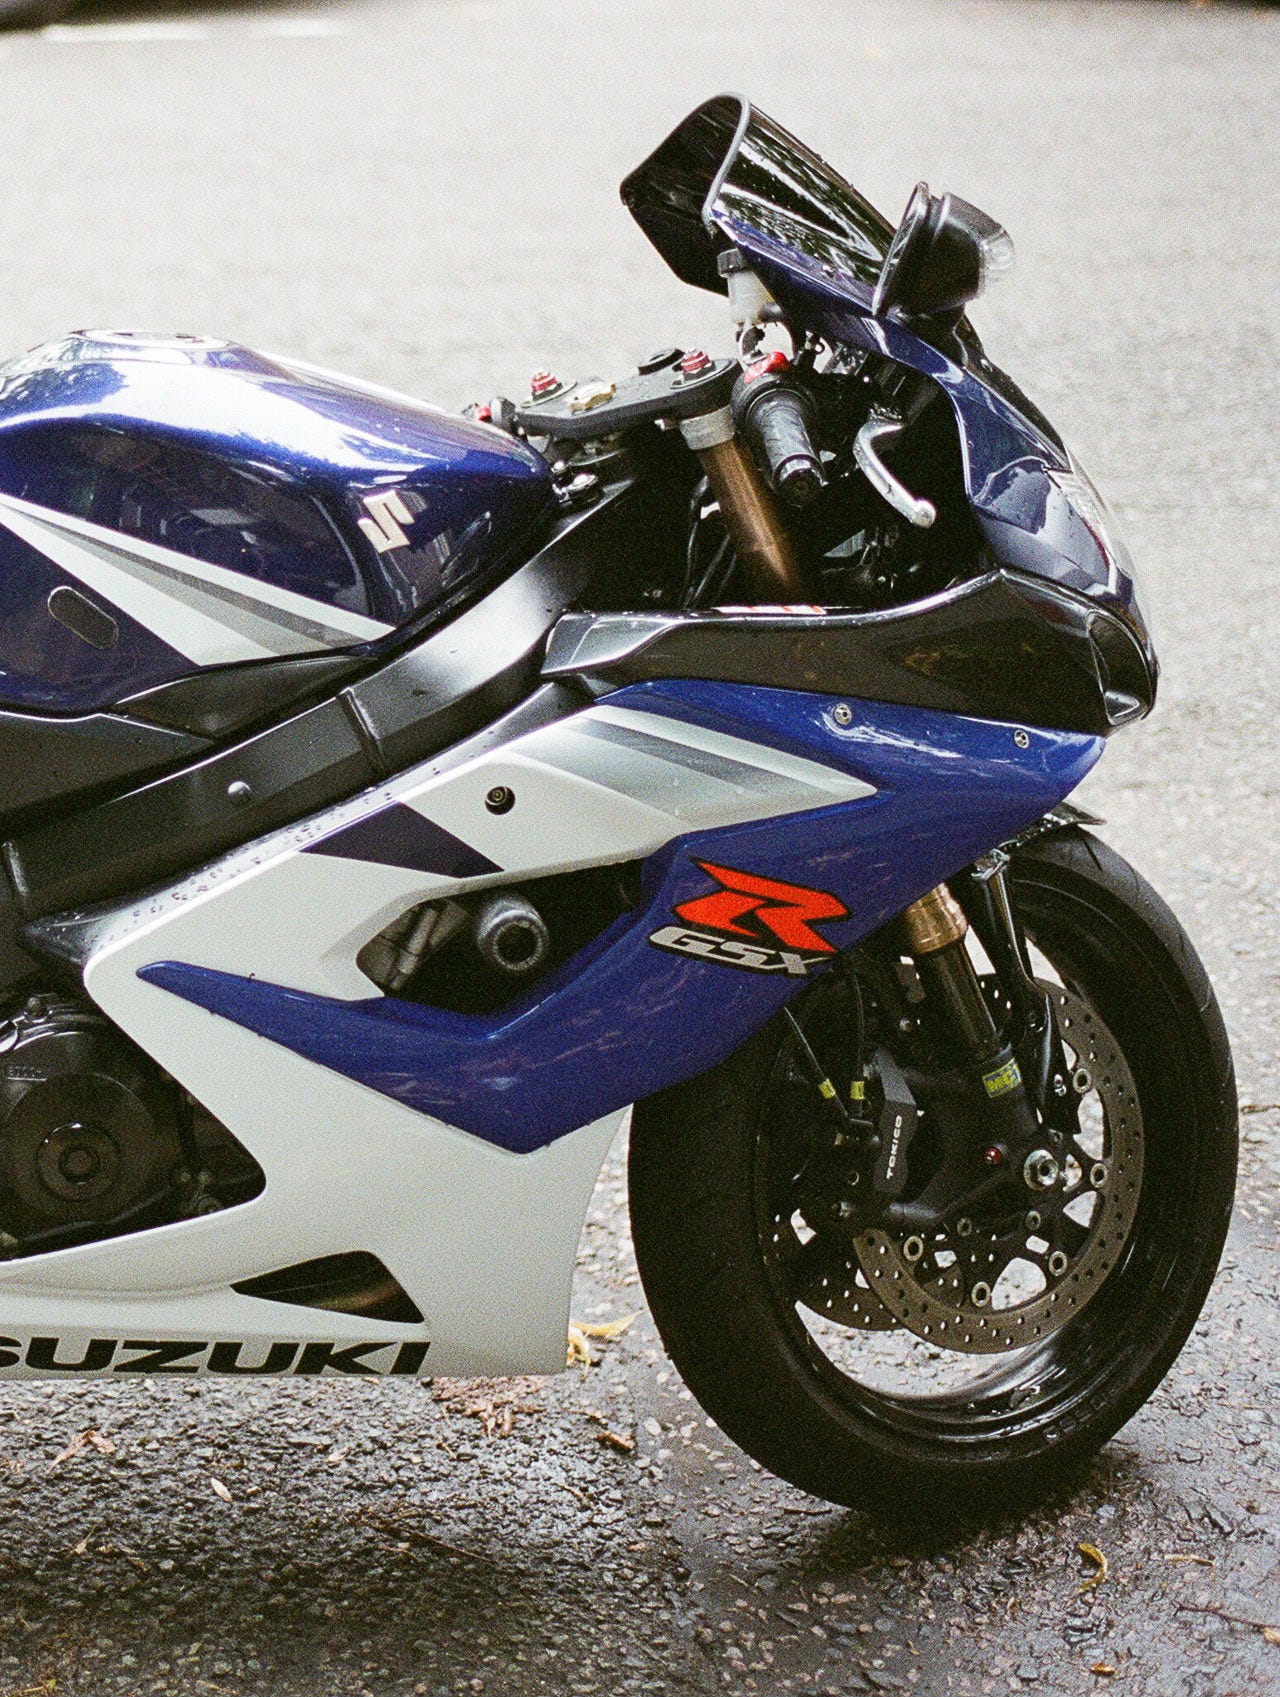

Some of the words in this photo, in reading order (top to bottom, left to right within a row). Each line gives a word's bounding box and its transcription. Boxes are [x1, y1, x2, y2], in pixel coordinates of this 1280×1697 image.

[674, 860, 849, 953] R
[649, 925, 830, 975] GSX
[886, 1115, 903, 1179] TOKICO
